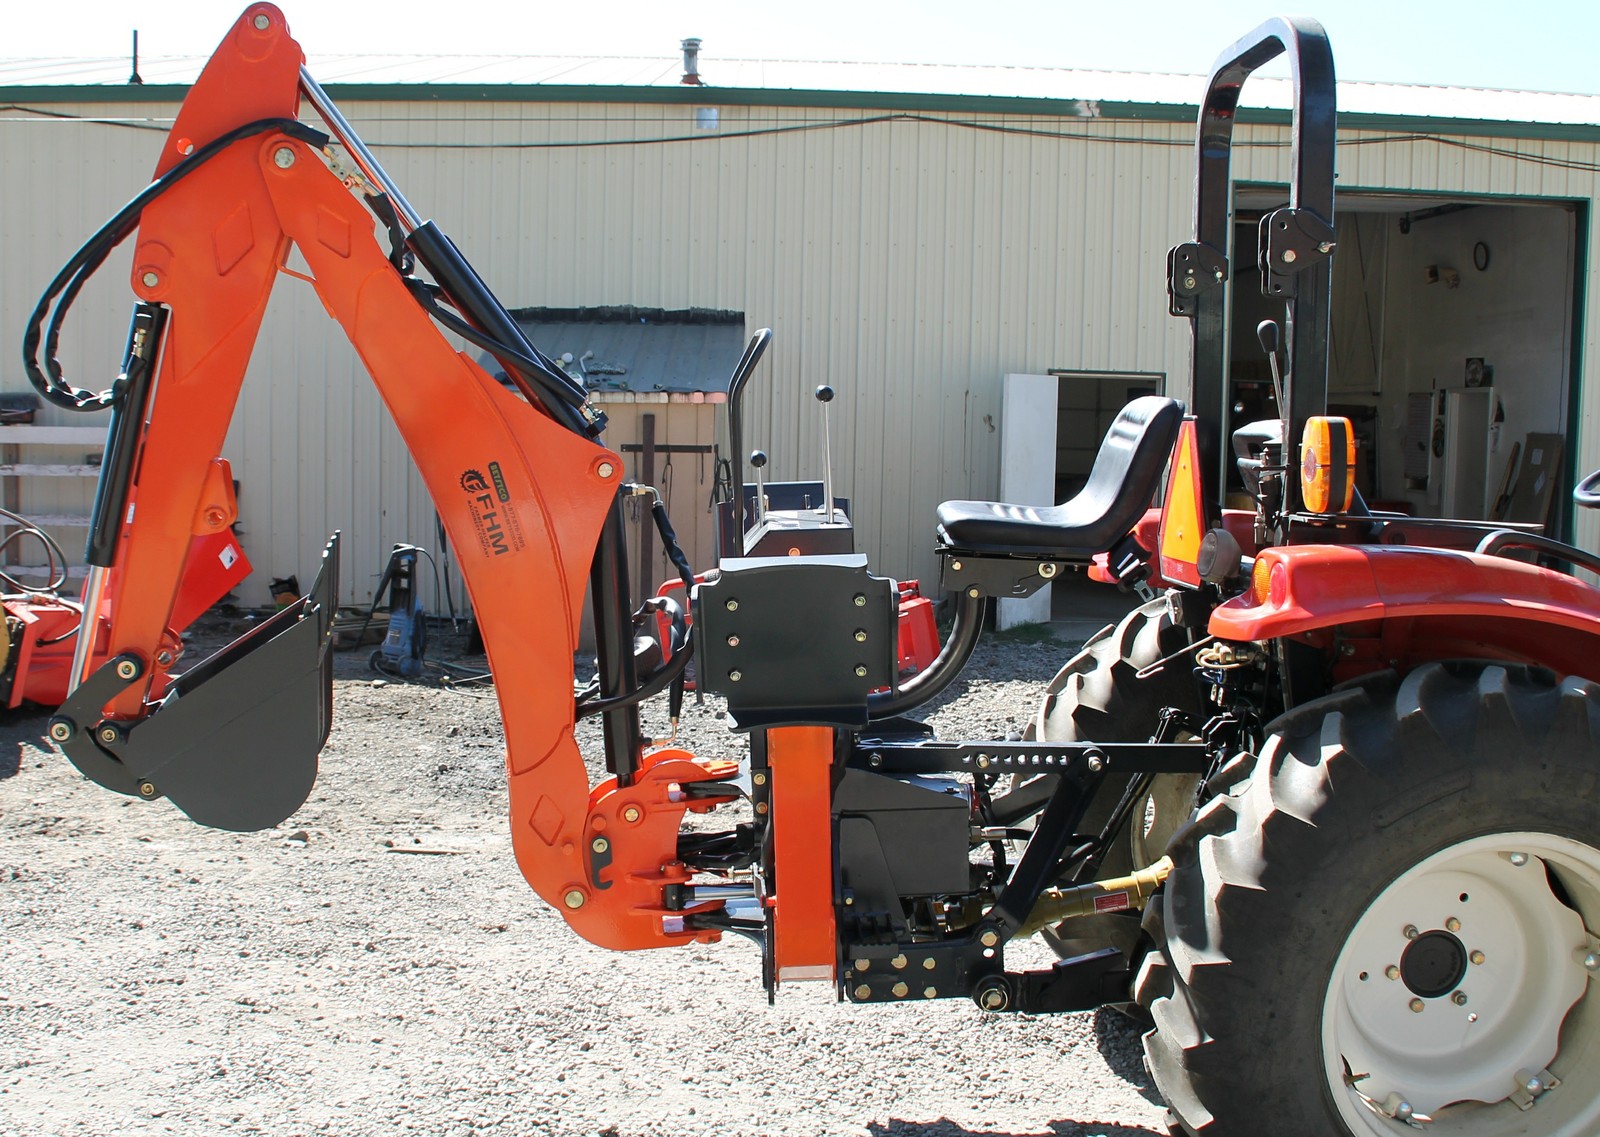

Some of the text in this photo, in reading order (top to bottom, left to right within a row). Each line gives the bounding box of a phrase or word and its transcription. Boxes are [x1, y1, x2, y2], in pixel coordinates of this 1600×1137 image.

[490, 464, 508, 500] BETSTCO
[467, 500, 490, 558] MACHINERY COMPANY
[476, 493, 509, 555] FHM
